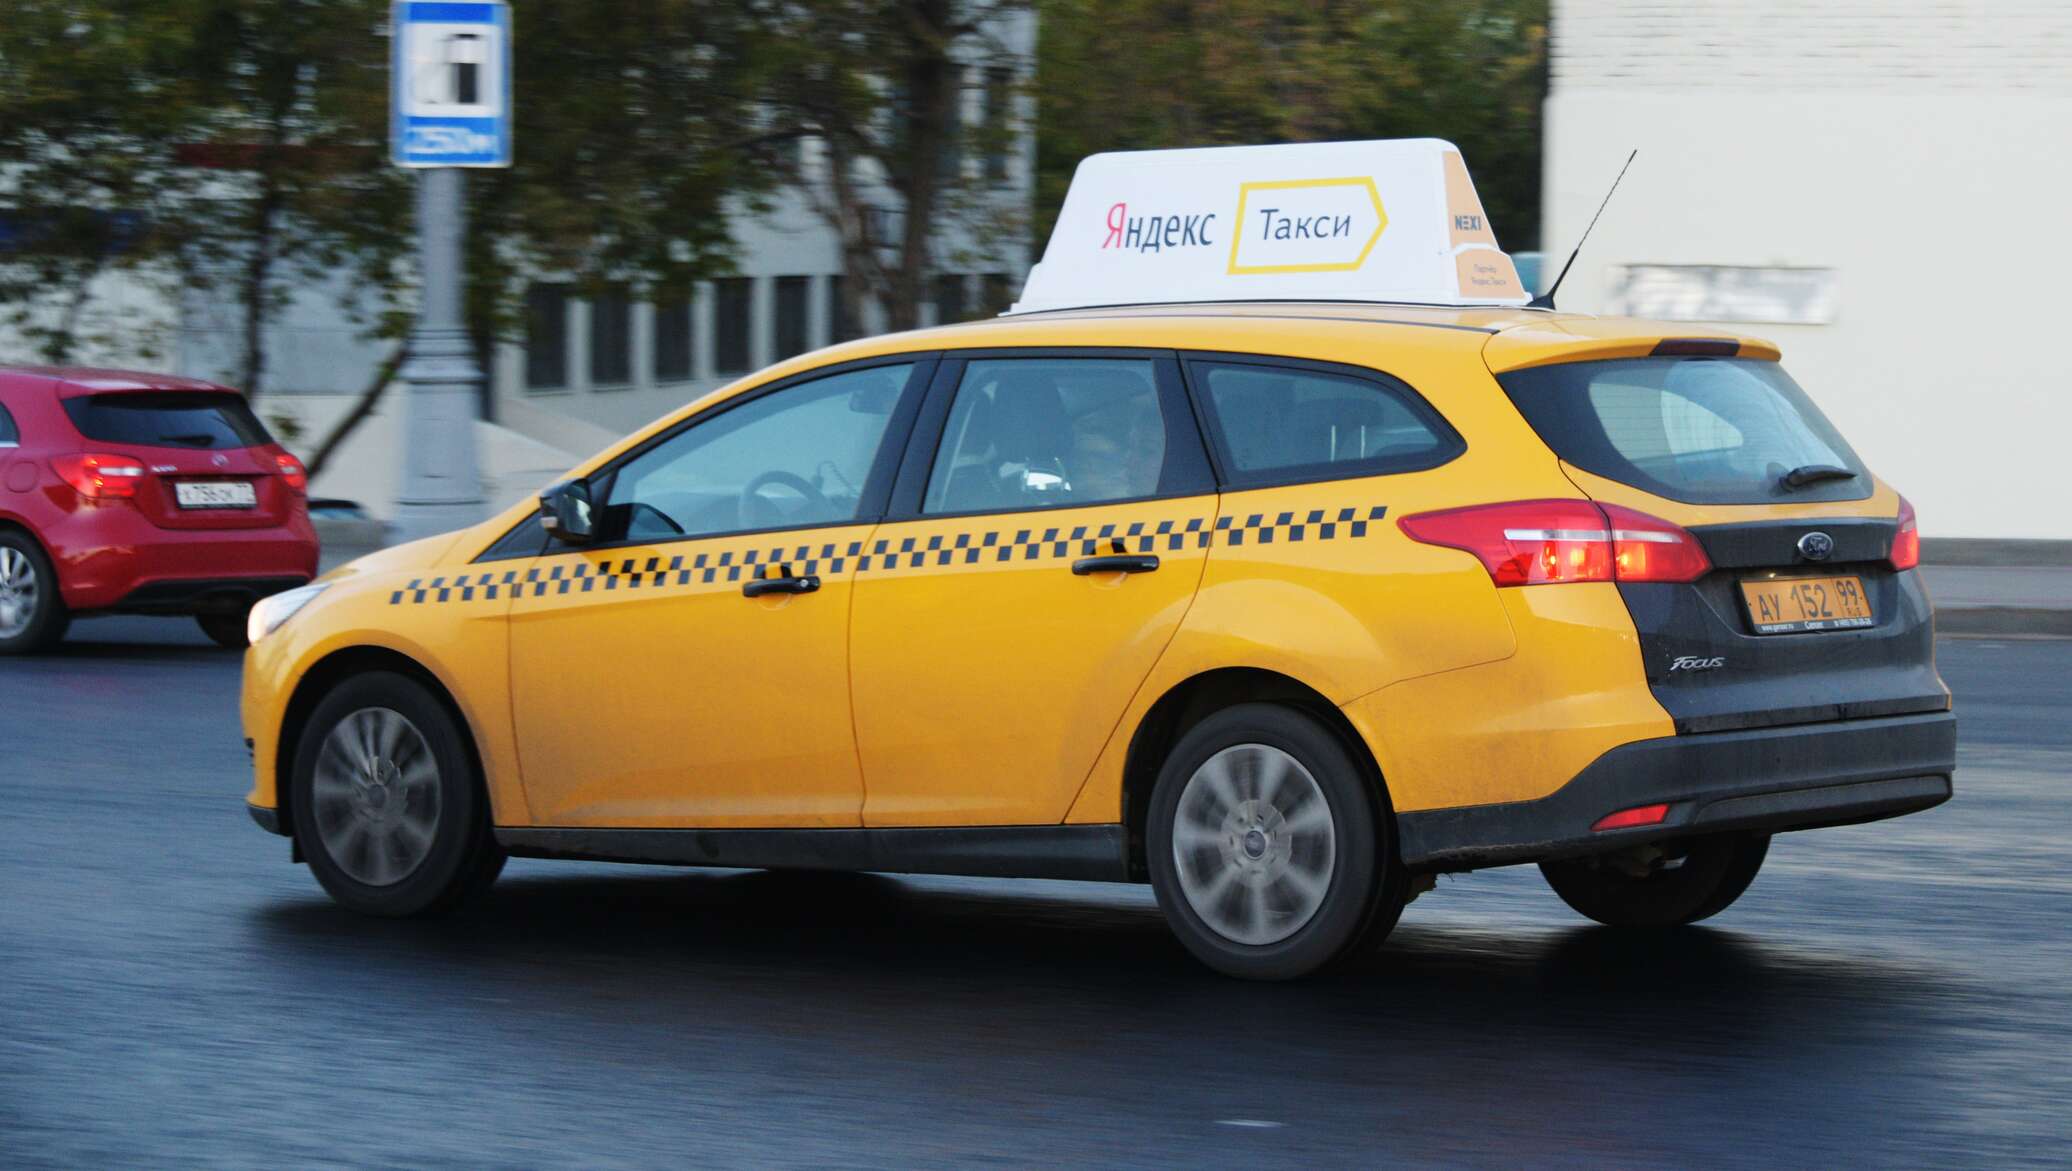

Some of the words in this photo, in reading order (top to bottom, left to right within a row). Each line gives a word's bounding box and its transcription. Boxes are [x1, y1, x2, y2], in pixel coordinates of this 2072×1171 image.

[1102, 202, 1216, 253] Яндекс
[1260, 208, 1351, 240] Такси
[1790, 584, 1833, 619] 152
[1836, 580, 1858, 606] 99
